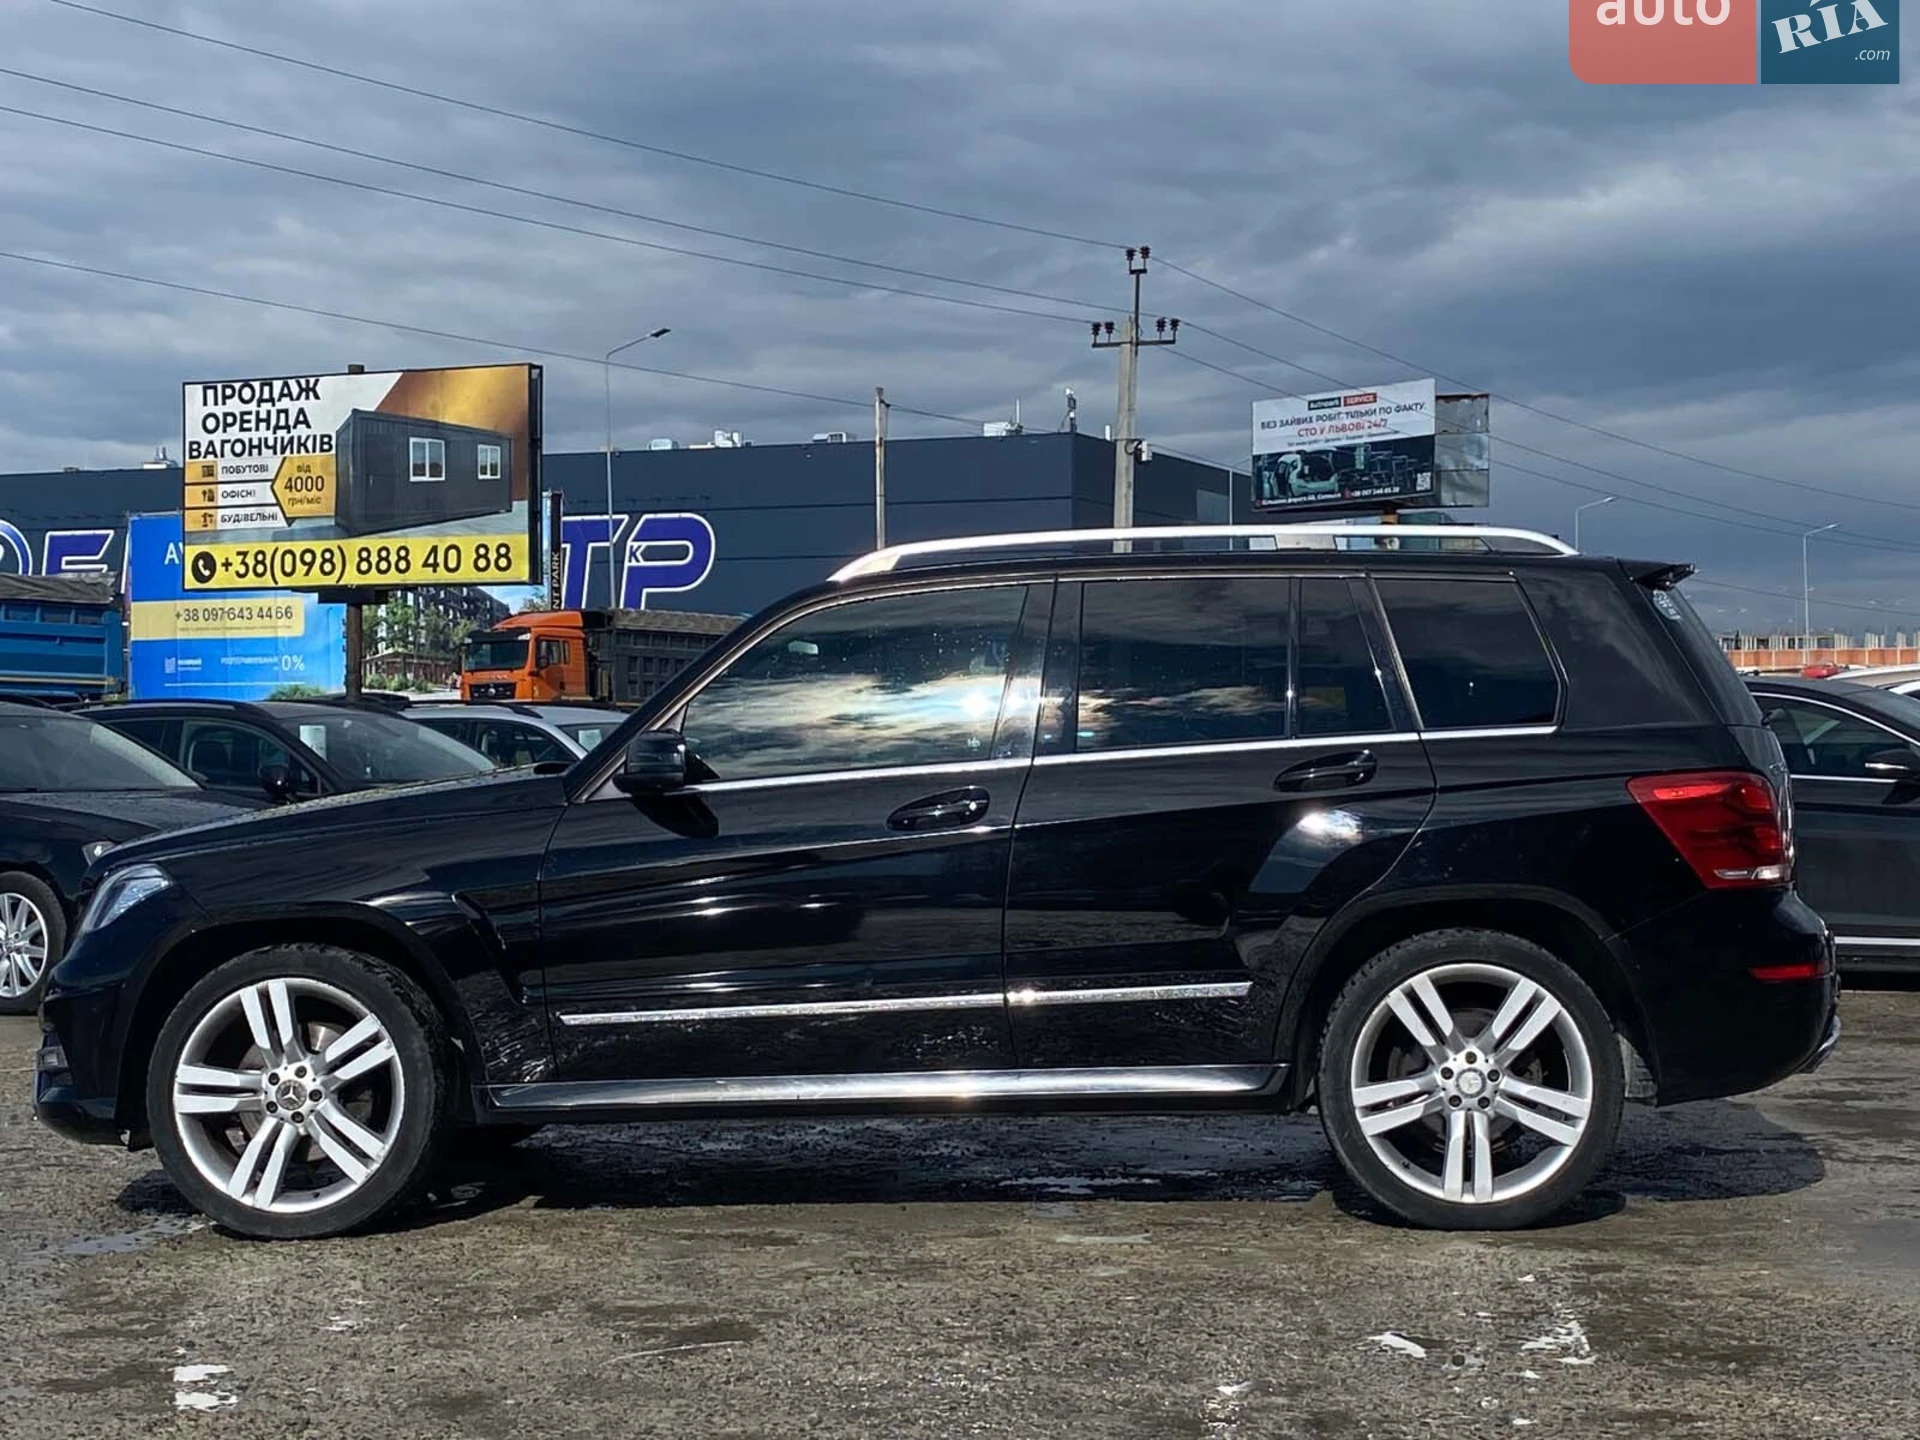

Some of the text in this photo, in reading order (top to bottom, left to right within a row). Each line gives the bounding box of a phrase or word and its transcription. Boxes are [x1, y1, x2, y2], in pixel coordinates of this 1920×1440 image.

[202, 378, 321, 407] ПРОДАЖ
[201, 407, 312, 435] ОРЕНДА
[1261, 420, 1277, 430] БЕЗ
[1346, 408, 1377, 420] ТІЛЬКИ
[1379, 406, 1392, 416] ПО
[1297, 417, 1388, 437] СТО У ЛЬВОВІ 24/7
[188, 434, 334, 460] ВАГОНЧИКІВ
[221, 464, 269, 475] ПОБУТОВІ
[297, 463, 312, 474] від
[284, 475, 325, 492] 4000
[221, 489, 257, 499] ОФІСНІ
[220, 512, 278, 524] БУДІВЕЛЬНІ
[221, 542, 513, 585] +38(098) 888 40 88
[551, 551, 560, 587] PARK
[175, 605, 294, 622] +38 097 643 44 66
[281, 654, 305, 671] 0%
